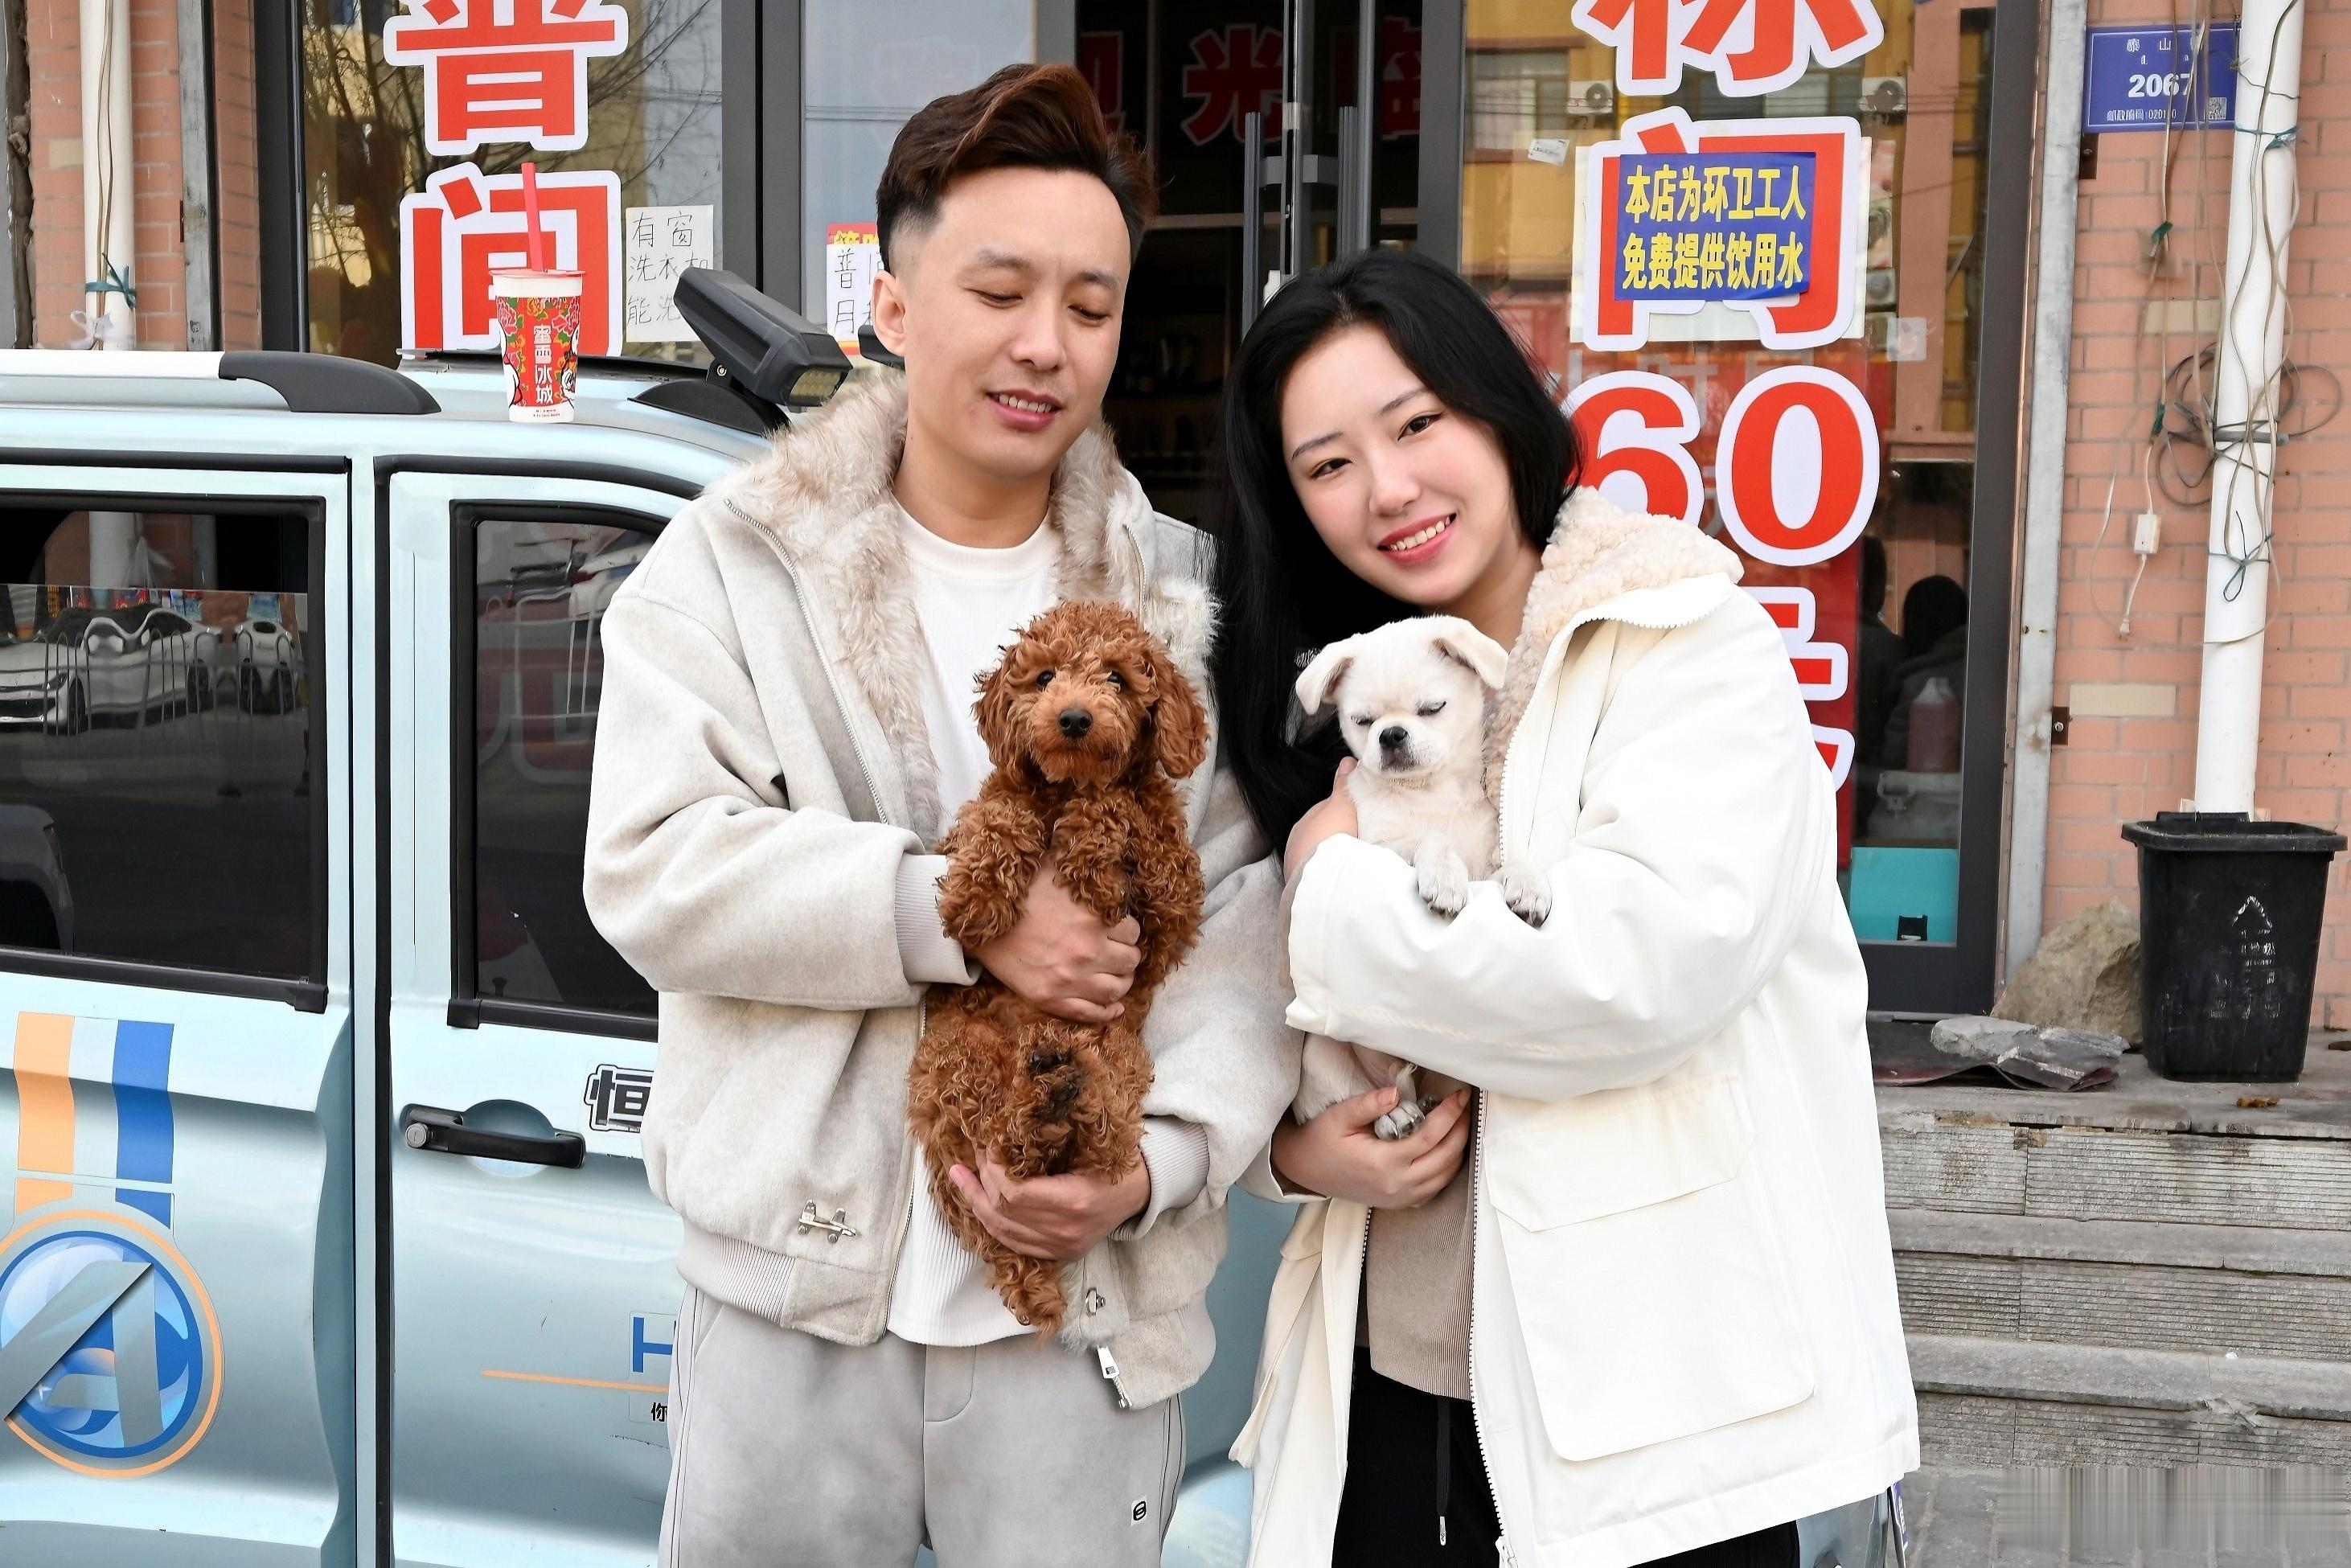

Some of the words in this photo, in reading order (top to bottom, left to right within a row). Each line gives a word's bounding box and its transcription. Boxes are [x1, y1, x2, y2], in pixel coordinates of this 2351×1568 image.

[2127, 72, 2190, 97] 2067
[1625, 164, 1807, 223] 本店为环卫工人
[632, 211, 692, 248] 有窗
[1623, 231, 1803, 290] 免费提供饮用水
[1566, 382, 1864, 550] 60
